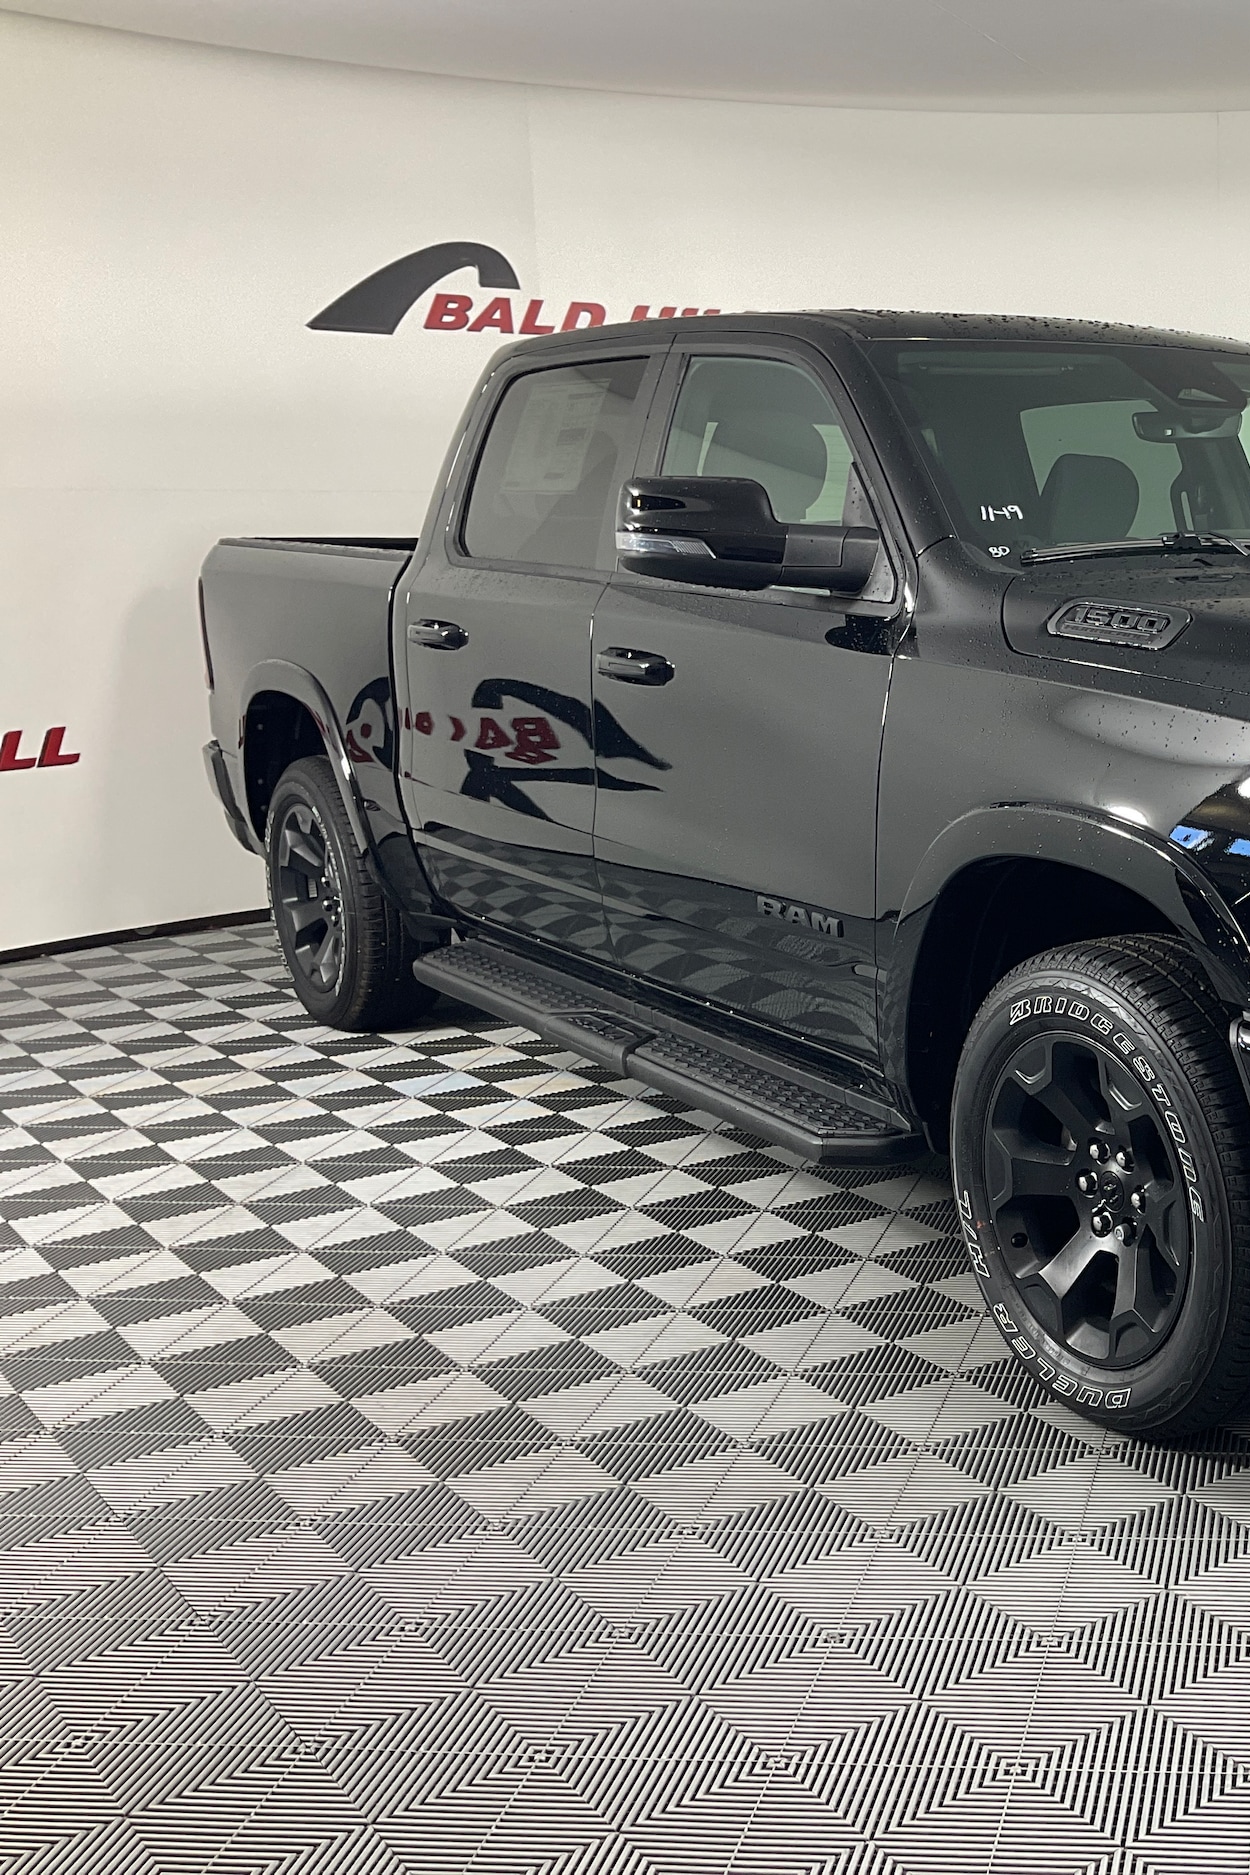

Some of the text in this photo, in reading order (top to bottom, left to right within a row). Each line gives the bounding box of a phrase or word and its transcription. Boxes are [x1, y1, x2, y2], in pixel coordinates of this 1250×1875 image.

[1072, 606, 1168, 634] 1500
[757, 895, 844, 938] RAM
[1009, 996, 1205, 1222] BRIDGESTONE
[993, 1303, 1131, 1409] DUELER
